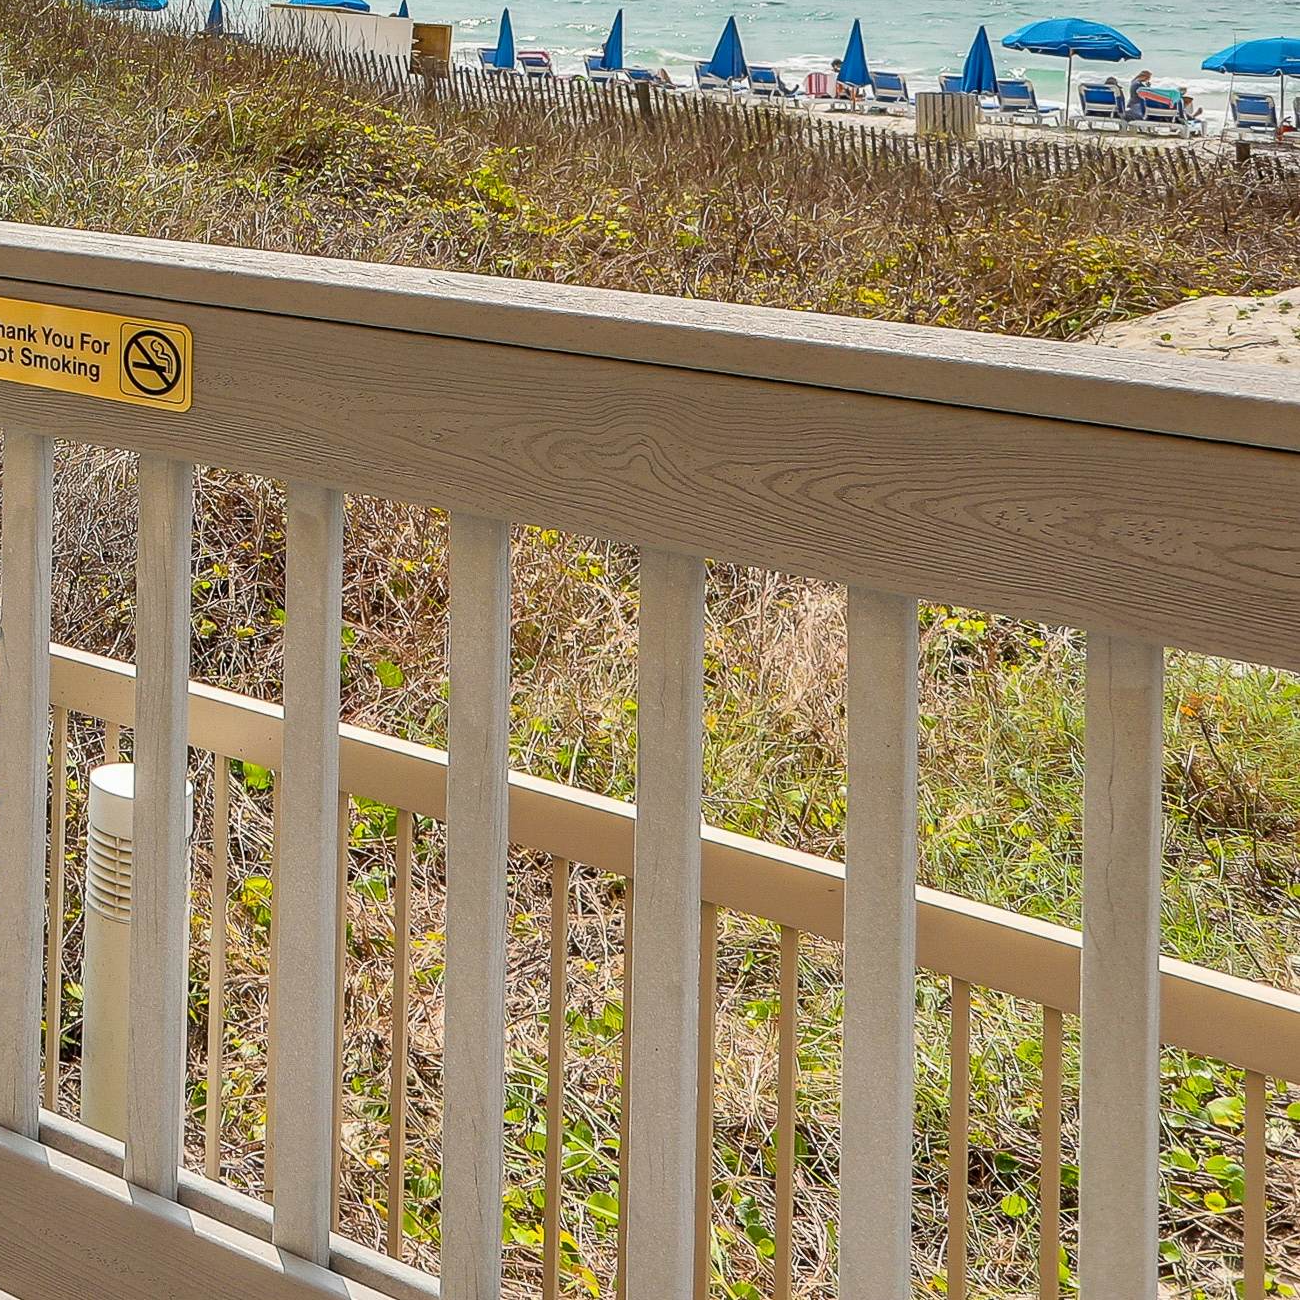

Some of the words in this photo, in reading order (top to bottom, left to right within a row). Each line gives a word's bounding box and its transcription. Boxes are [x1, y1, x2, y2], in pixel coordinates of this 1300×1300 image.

[42, 326, 74, 349] You
[80, 333, 110, 355] For
[20, 347, 100, 382] Smoking
